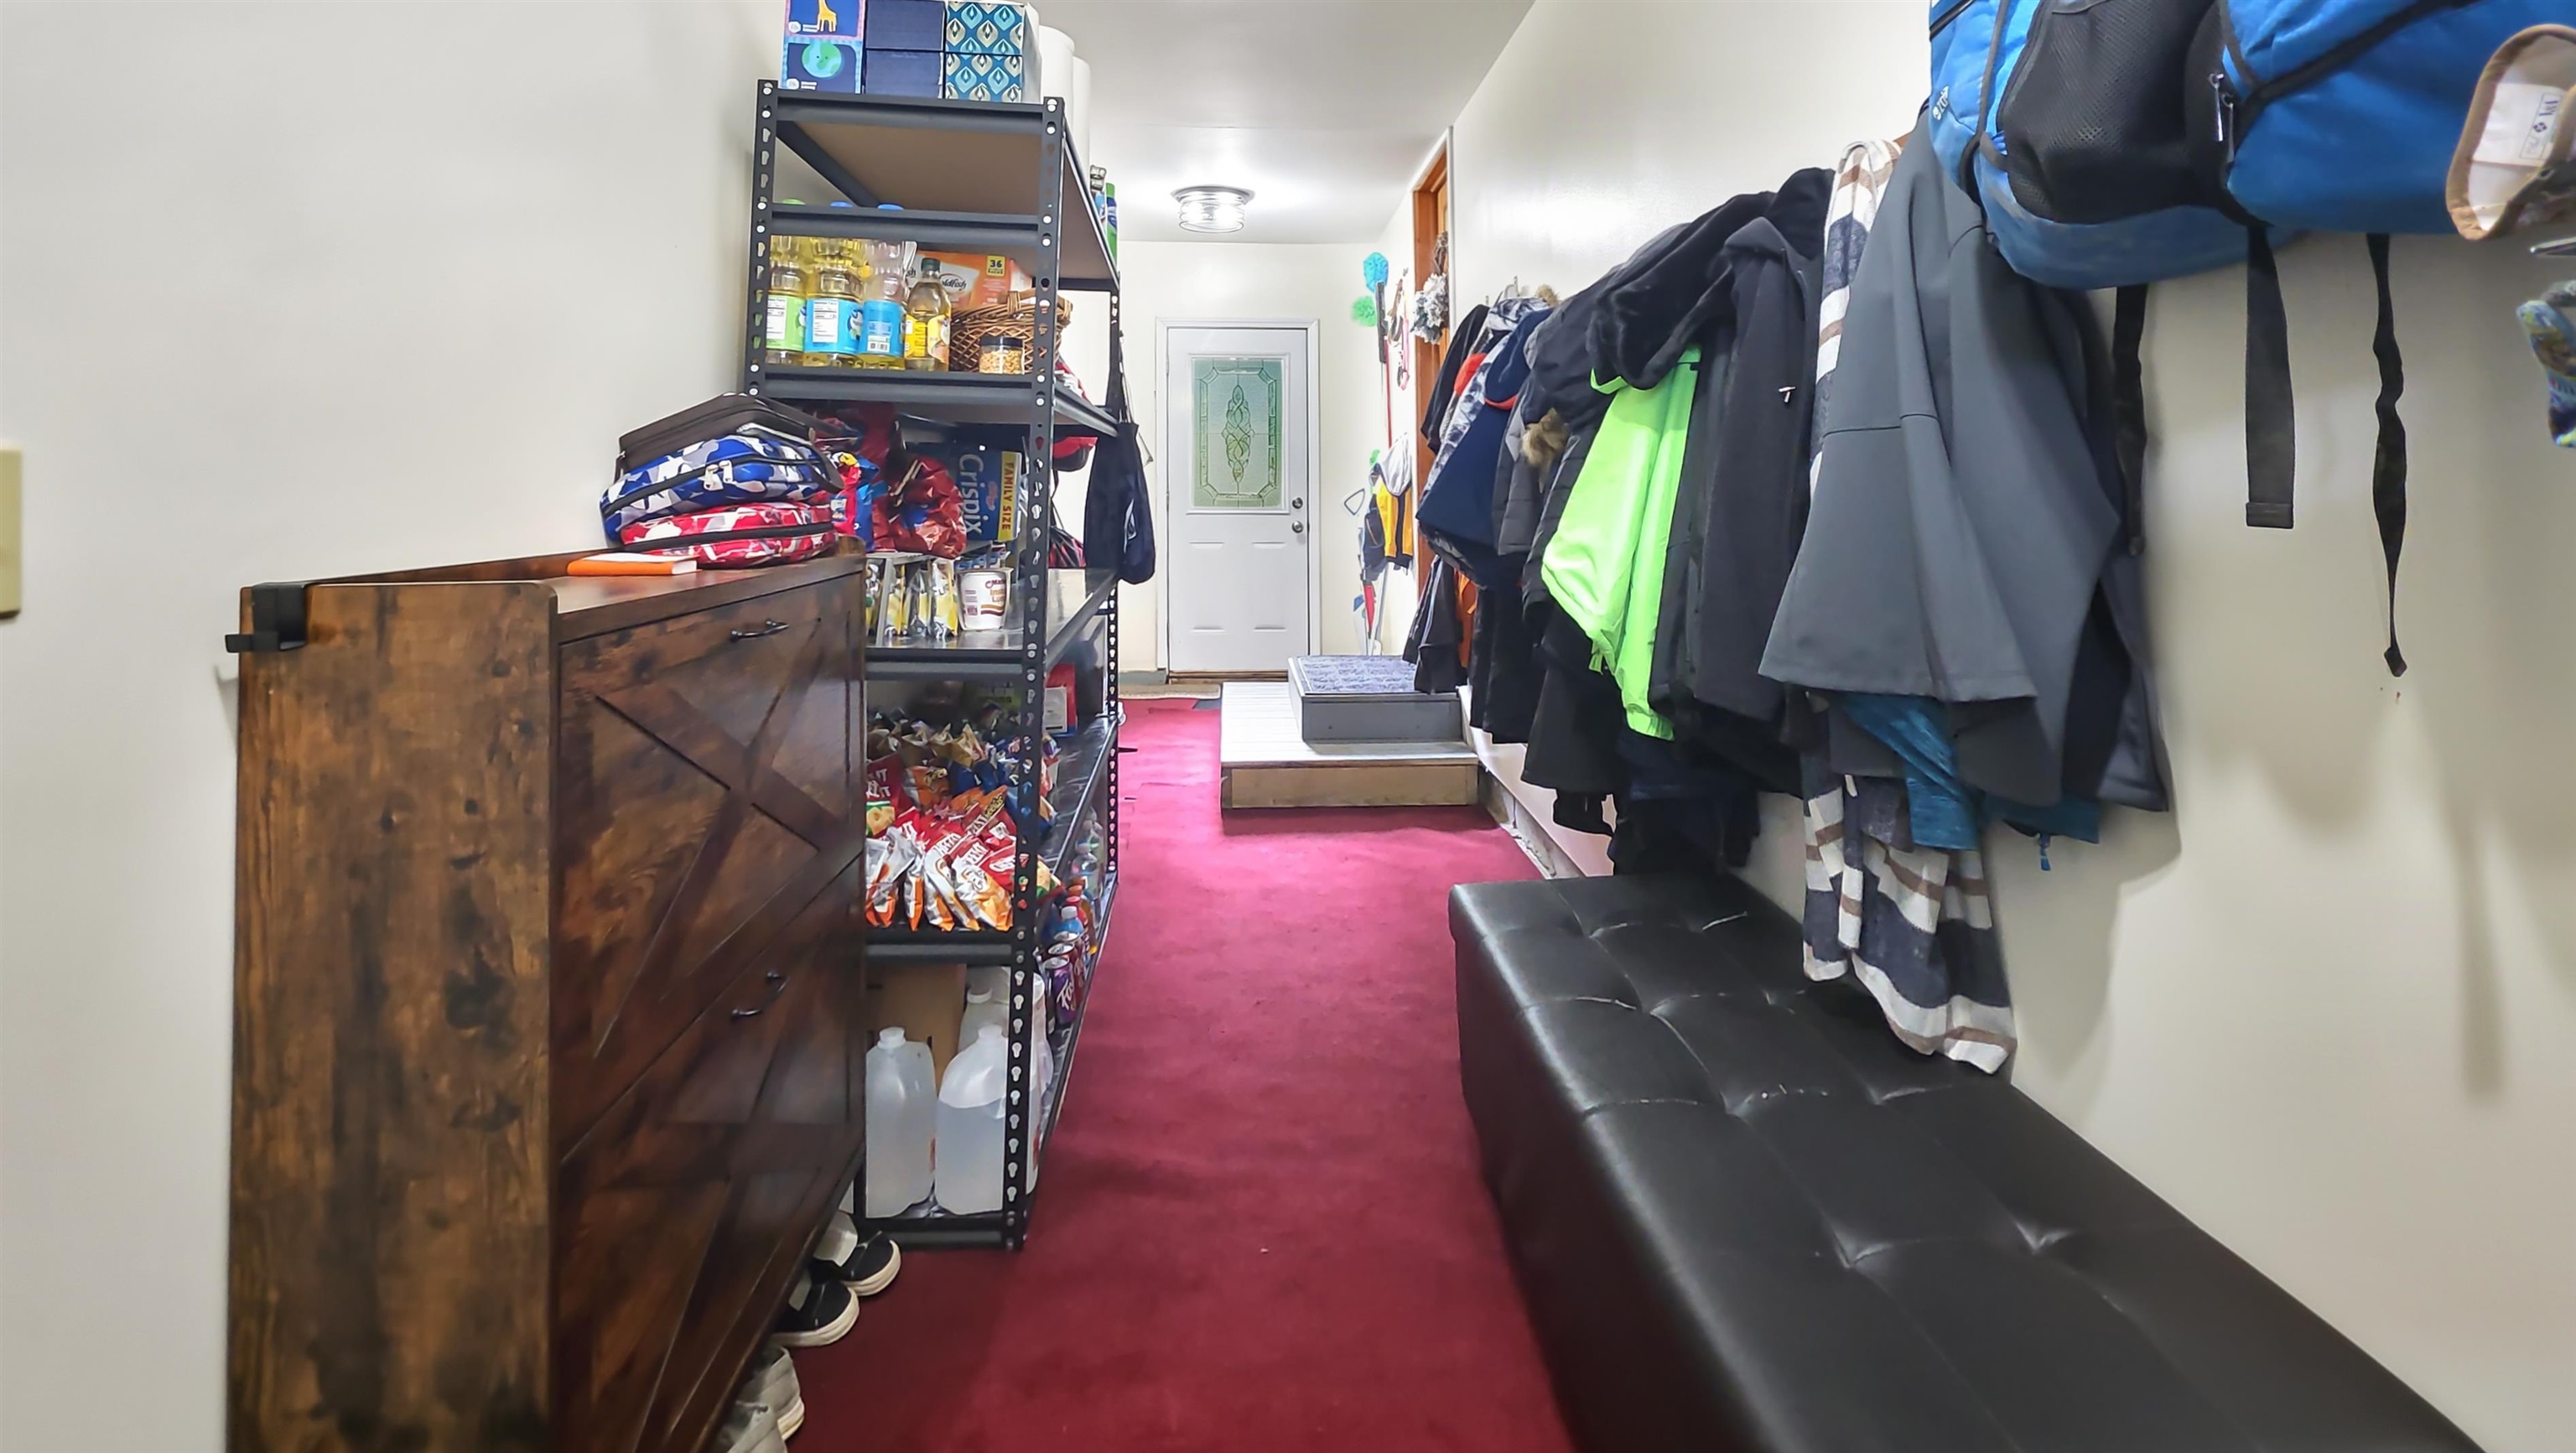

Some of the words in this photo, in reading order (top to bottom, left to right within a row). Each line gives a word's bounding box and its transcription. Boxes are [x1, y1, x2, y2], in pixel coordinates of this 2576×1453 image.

[989, 259, 1002, 268] 36
[958, 454, 989, 534] Crispix
[1003, 463, 1014, 501] FAMILY
[1002, 506, 1011, 530] SIZE
